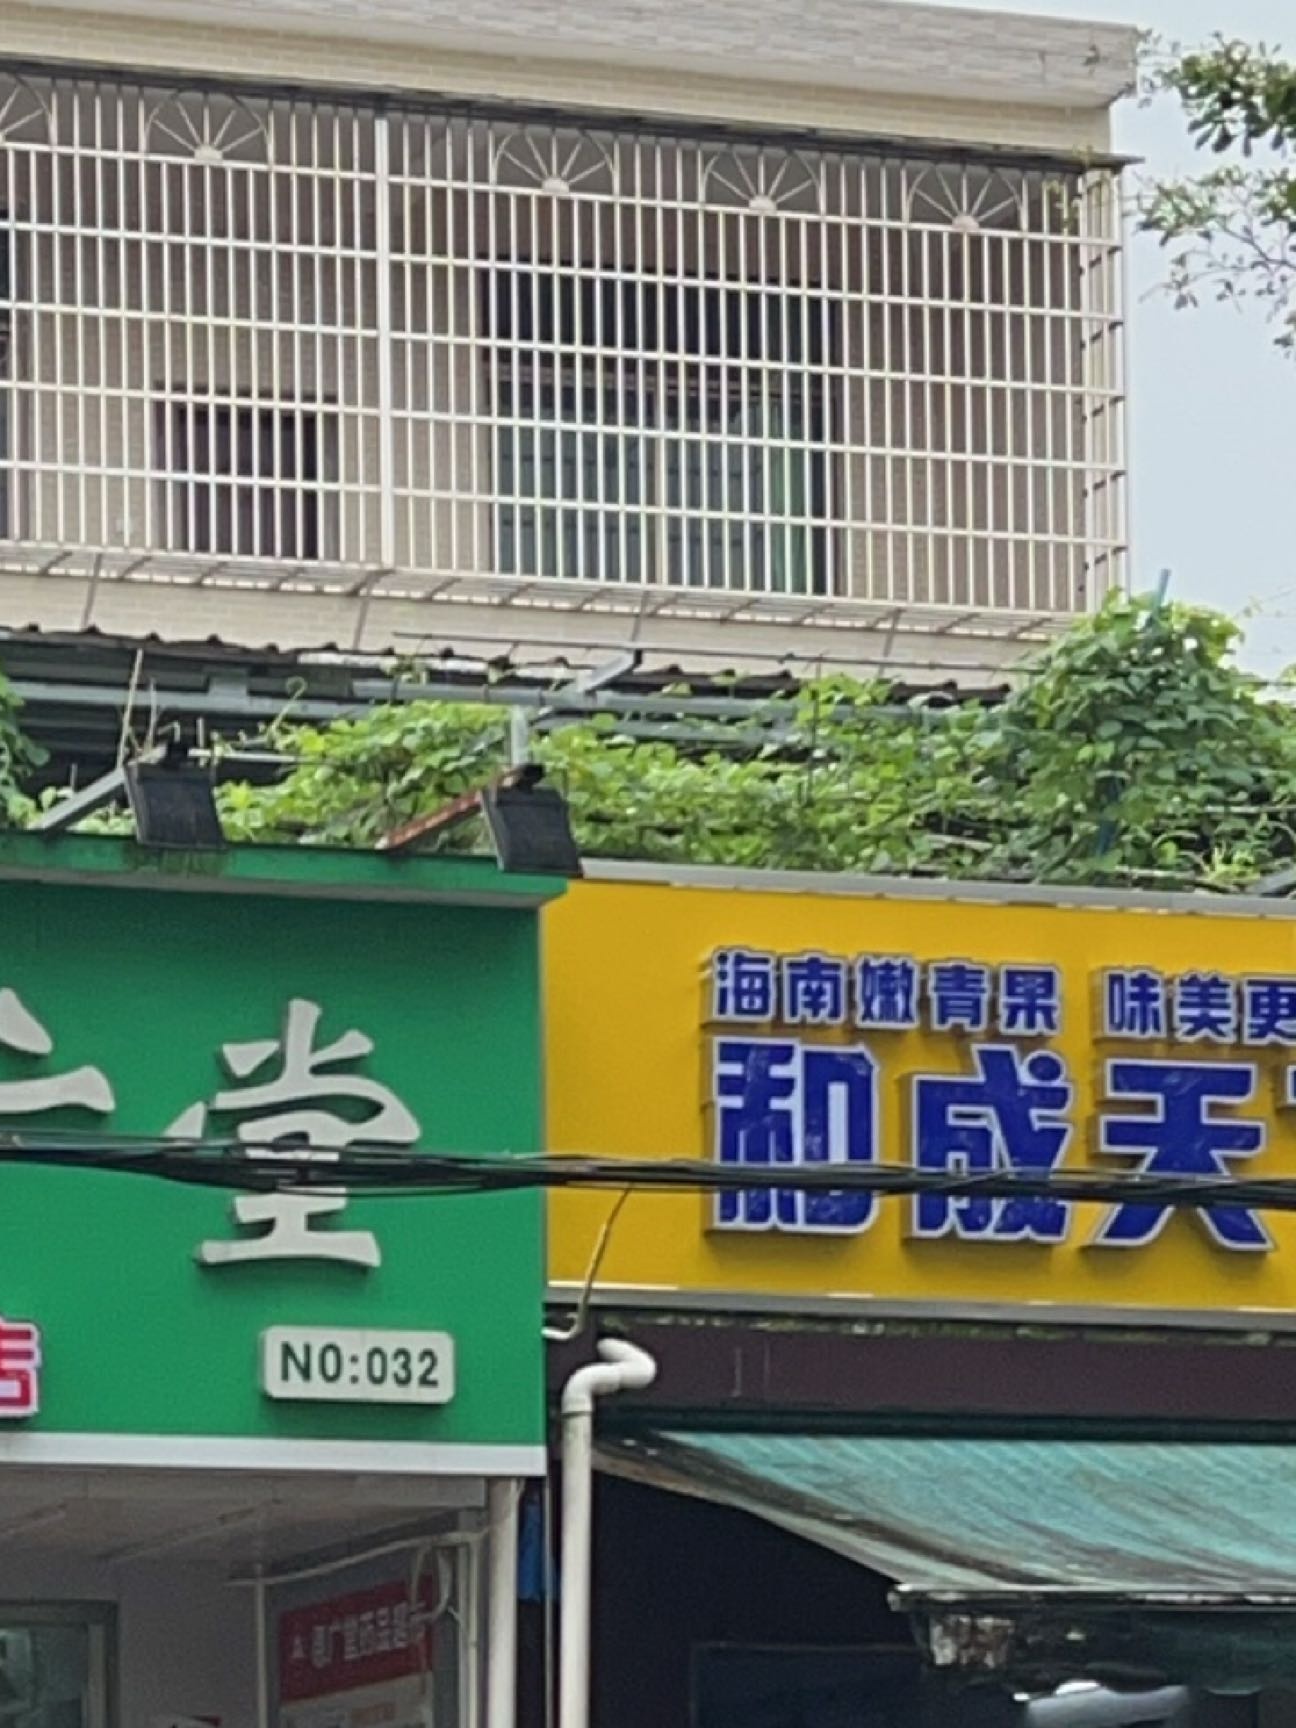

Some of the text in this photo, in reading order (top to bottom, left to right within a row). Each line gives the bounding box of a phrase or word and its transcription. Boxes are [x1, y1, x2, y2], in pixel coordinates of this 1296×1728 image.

[707, 948, 1296, 1046] 海南嫩青果 味美更
[707, 1037, 1296, 1252] 和成天
